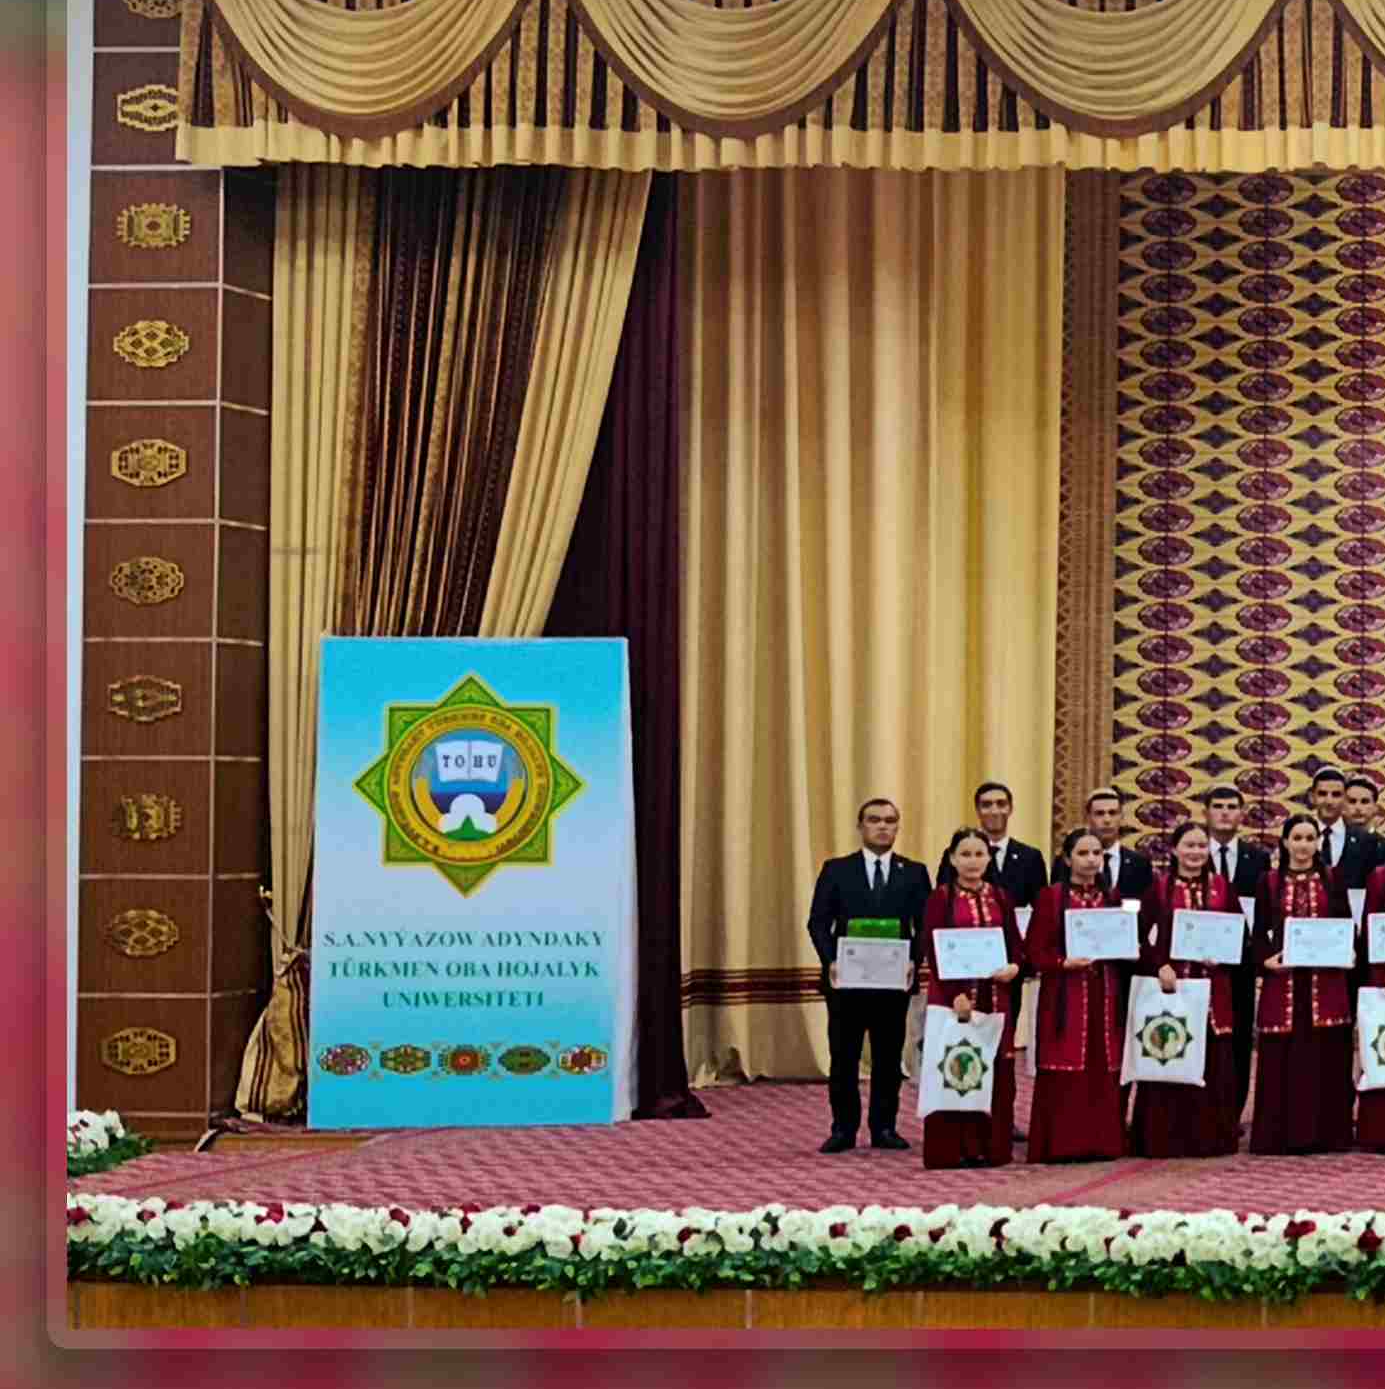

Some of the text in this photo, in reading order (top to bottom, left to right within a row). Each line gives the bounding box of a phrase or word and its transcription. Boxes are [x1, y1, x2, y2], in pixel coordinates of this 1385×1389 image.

[482, 930, 605, 948] ADYNDAKY
[328, 957, 601, 979] TÜRKMEN OBA HOJALYK
